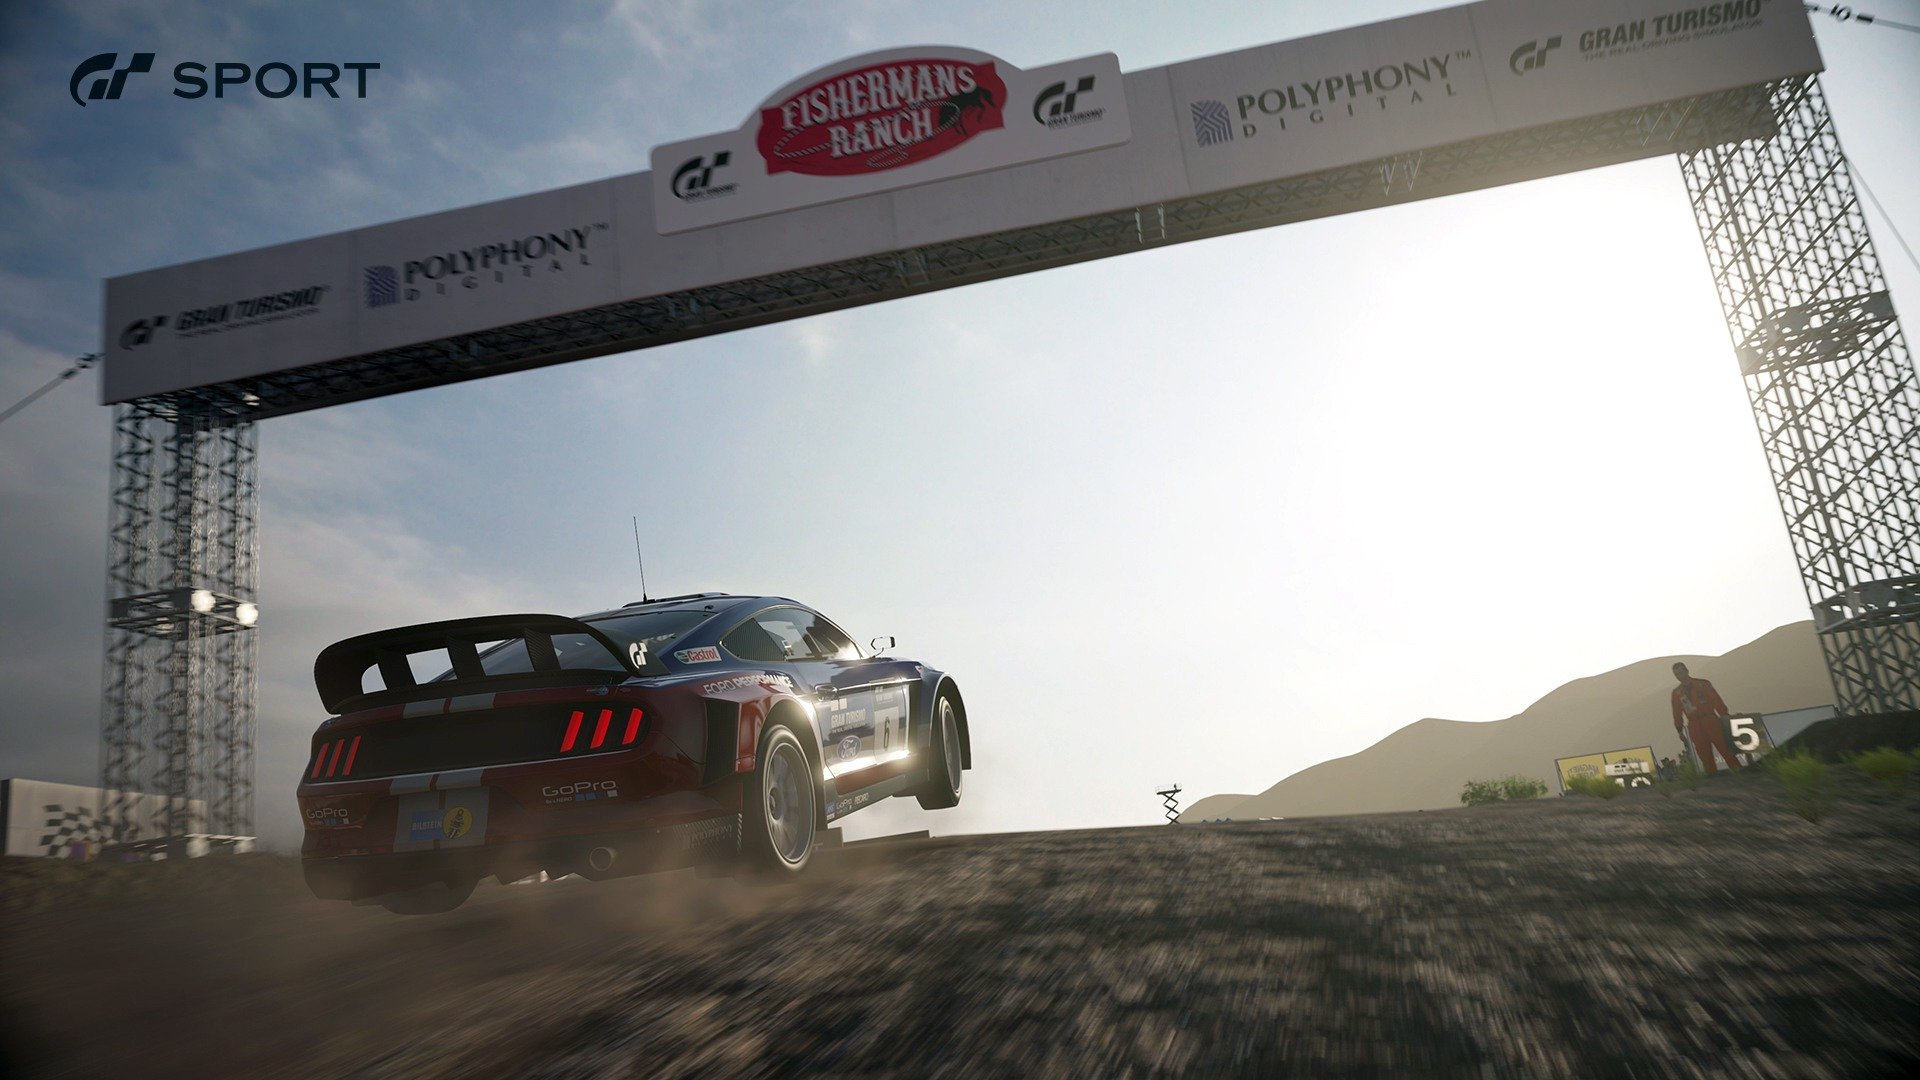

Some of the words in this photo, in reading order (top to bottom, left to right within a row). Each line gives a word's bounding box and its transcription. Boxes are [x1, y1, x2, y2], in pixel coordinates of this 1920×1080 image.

[1579, 18, 1646, 52] GRAN
[781, 64, 977, 131] FISHERMANS
[1236, 54, 1450, 120] POLYPHONY
[828, 108, 933, 158] RANCH
[403, 226, 591, 284] POLYPHONY
[688, 648, 718, 662] Castrol
[703, 679, 736, 696] FORD
[883, 716, 891, 752] 6
[1730, 718, 1760, 751] 5
[542, 781, 617, 797] GoPro
[306, 807, 348, 819] GoPro
[412, 821, 442, 831] BILSTEIN
